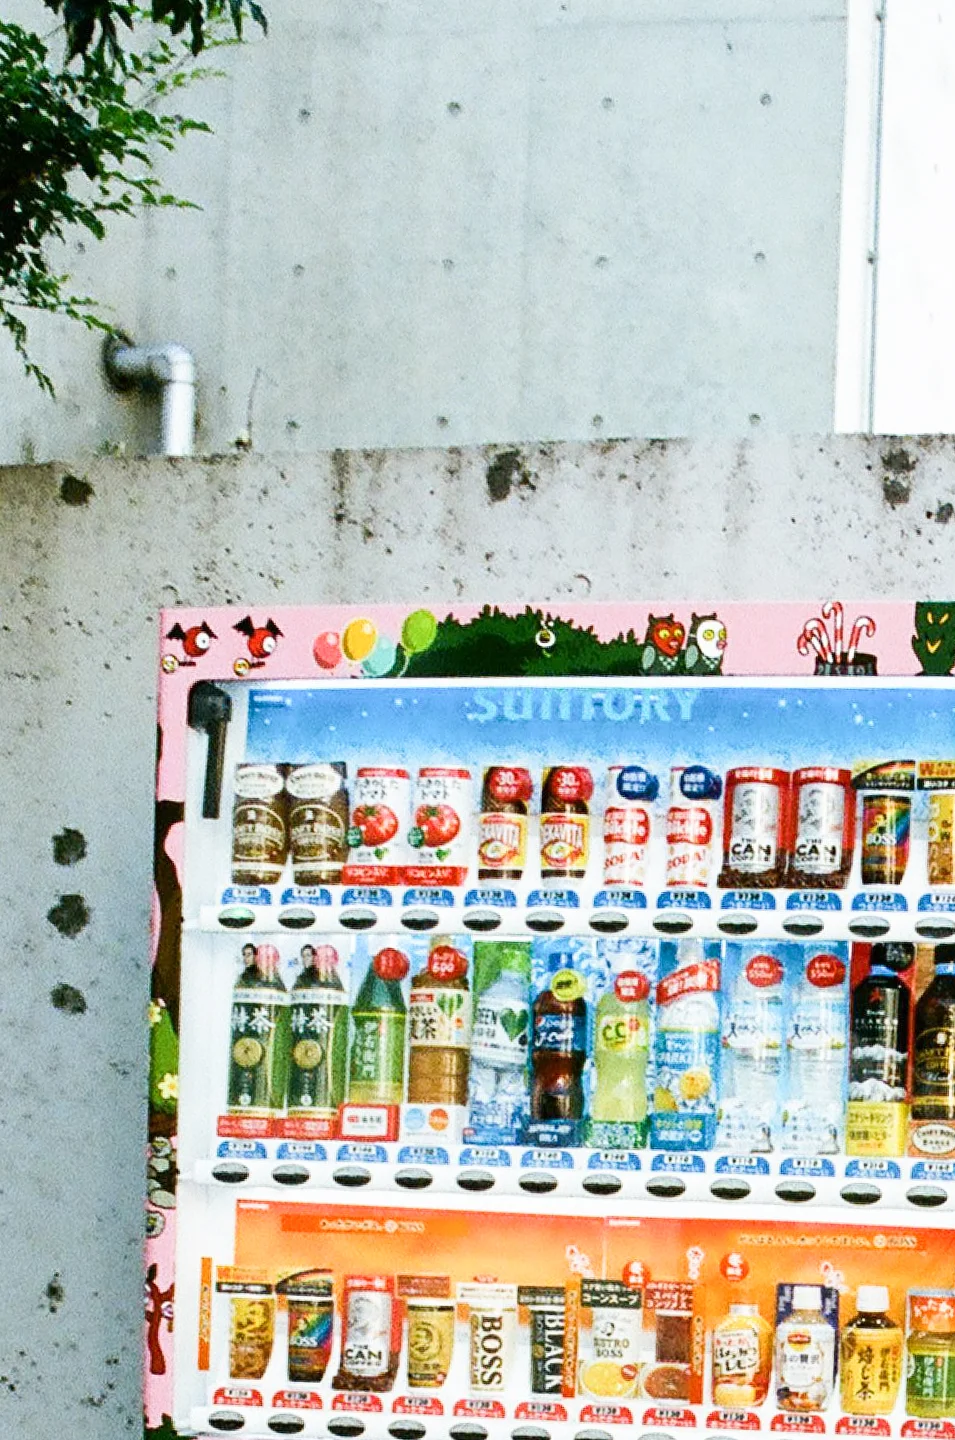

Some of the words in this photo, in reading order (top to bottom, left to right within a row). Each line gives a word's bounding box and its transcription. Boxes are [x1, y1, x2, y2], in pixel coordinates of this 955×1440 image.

[731, 844, 772, 856] CAN
[796, 844, 837, 856] CAN
[582, 1293, 640, 1305] コーンスープ
[345, 1349, 383, 1361] CAN
[481, 1316, 503, 1386] BOSS
[544, 1314, 565, 1391] BLACK
